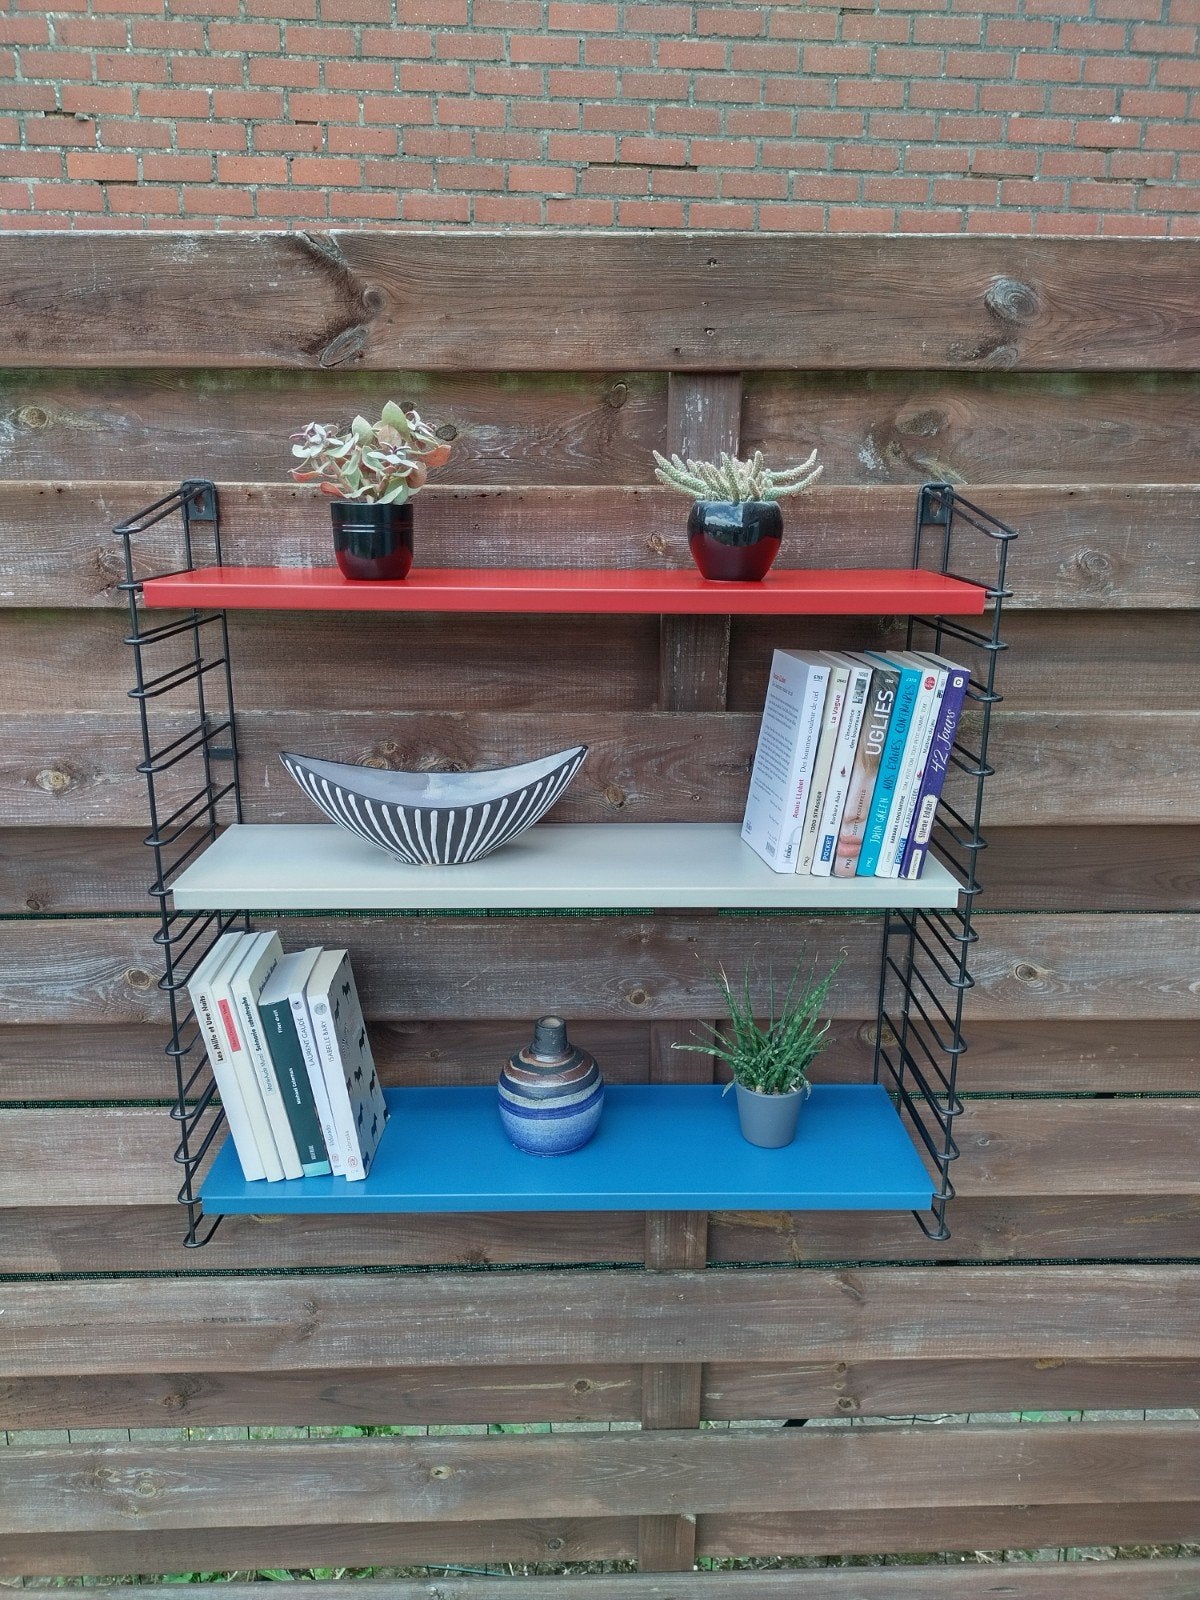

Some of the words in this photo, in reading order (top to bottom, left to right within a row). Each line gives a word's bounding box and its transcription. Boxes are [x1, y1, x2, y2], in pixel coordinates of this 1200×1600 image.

[810, 701, 817, 711] de
[831, 693, 842, 715] Vague
[806, 711, 816, 734] couleur
[829, 715, 837, 723] La
[850, 708, 862, 738] bourreaux
[864, 688, 895, 756] UGLIES
[933, 707, 959, 750] Jours
[881, 774, 895, 790] NOS
[893, 682, 916, 734] CONTRAIRES
[926, 727, 933, 735] du
[801, 735, 812, 759] hommes
[799, 760, 807, 773] Des
[929, 749, 948, 773] 42
[794, 778, 804, 799] LLobet
[833, 789, 842, 803] Abel
[811, 790, 823, 818] STRASSER
[829, 803, 839, 824] Barbara
[873, 795, 890, 823] GREEN
[921, 798, 934, 819] Edgar
[809, 819, 817, 833] TODD
[889, 824, 898, 844] BARBARA
[894, 794, 905, 823] CONSTANTINE
[869, 823, 883, 844] JOHN
[821, 834, 833, 861] POCKET
[894, 837, 907, 864] POCKET
[198, 995, 208, 1011] Nuits
[241, 996, 255, 1028] catastrophe
[204, 1012, 213, 1025] Une
[320, 1020, 328, 1035] BARY
[210, 1034, 220, 1050] Mille
[303, 1039, 315, 1066] LAURENT
[324, 1037, 334, 1062] ISABELLE
[215, 1051, 224, 1062] Les
